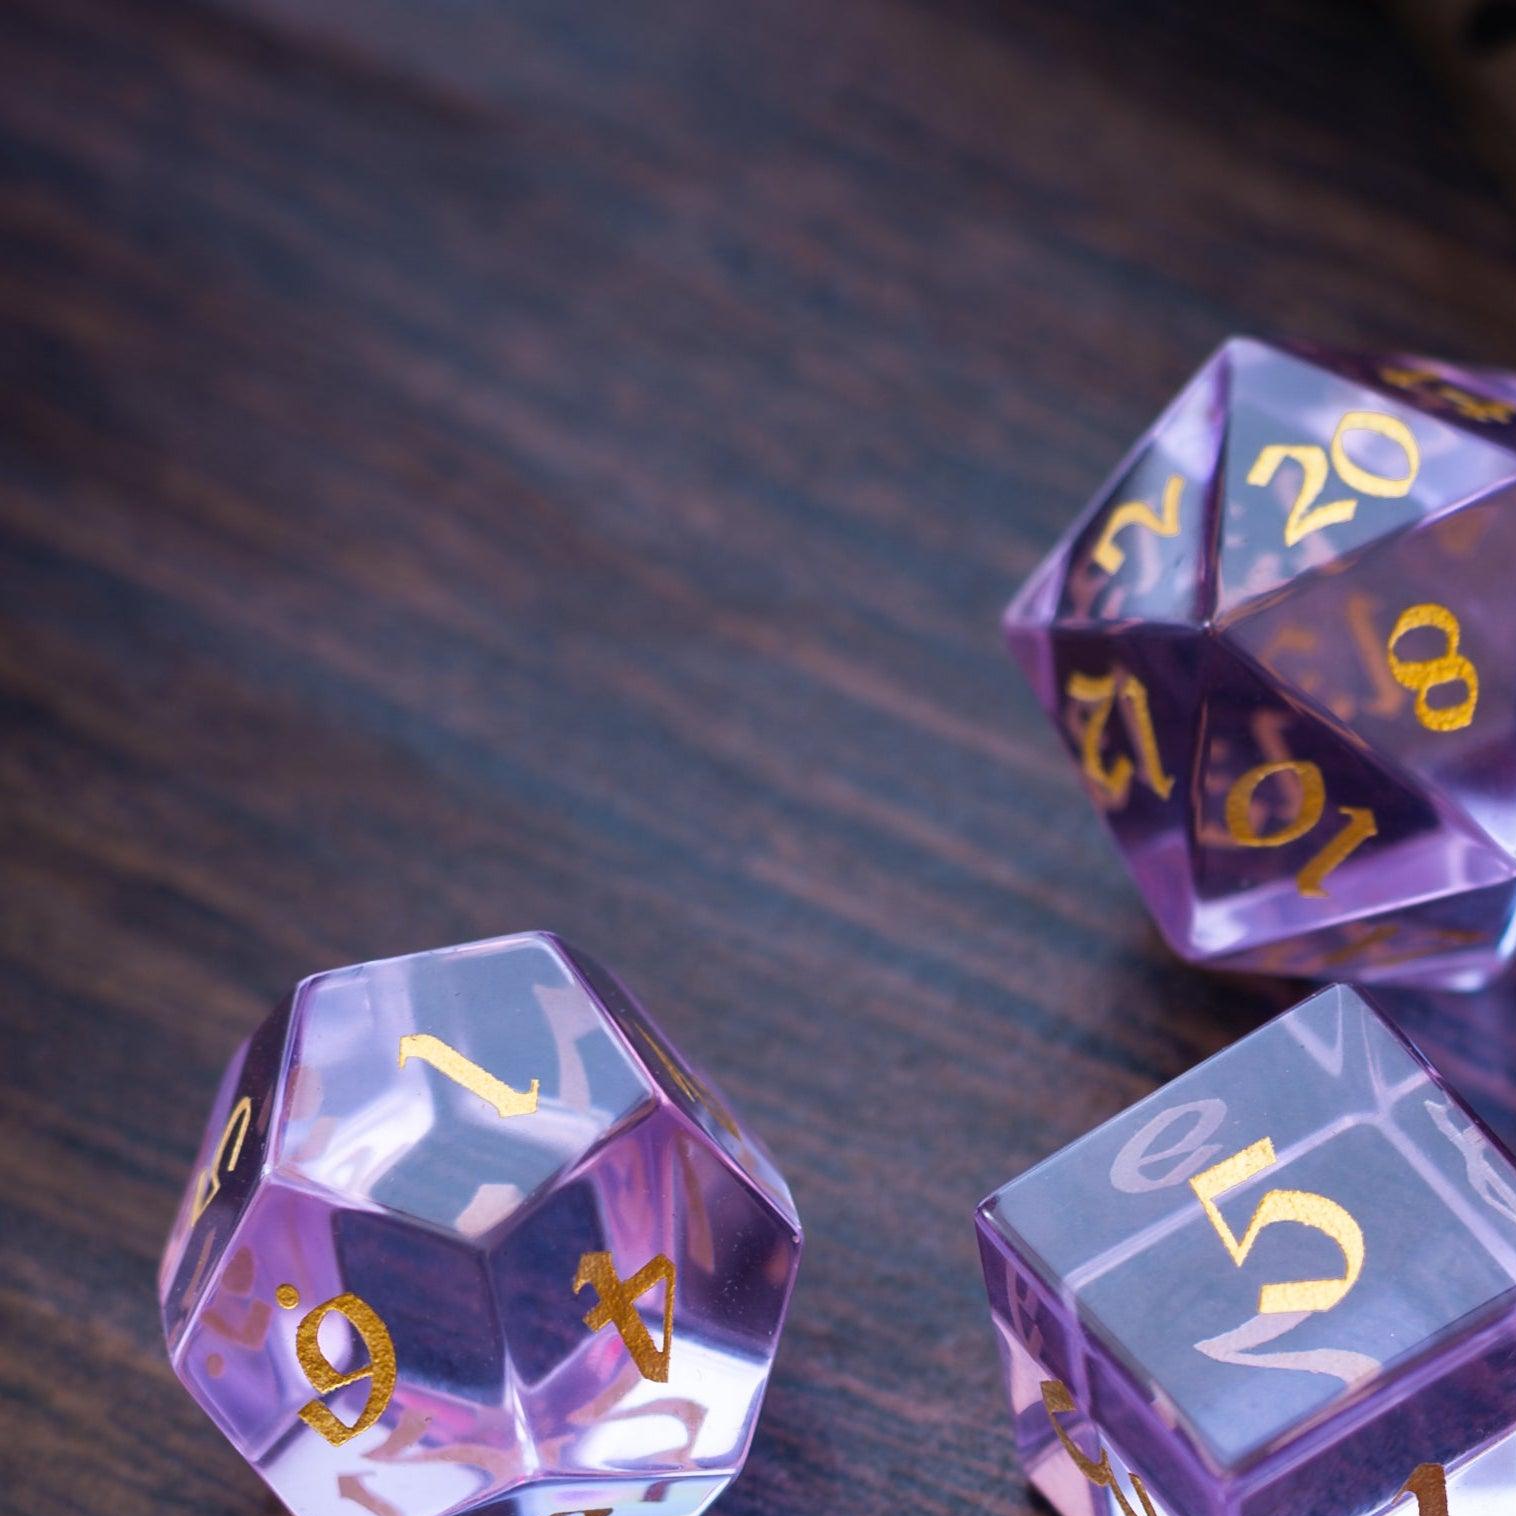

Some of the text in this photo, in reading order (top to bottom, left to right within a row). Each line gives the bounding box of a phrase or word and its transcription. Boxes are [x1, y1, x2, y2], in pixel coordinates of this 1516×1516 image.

[1093, 475, 1184, 575] 2
[1247, 411, 1420, 547] 20
[1387, 603, 1480, 732] 8
[1225, 760, 1378, 898] 10
[399, 1032, 539, 1119] 1
[1188, 1136, 1366, 1315] 5
[572, 1251, 676, 1384] 4
